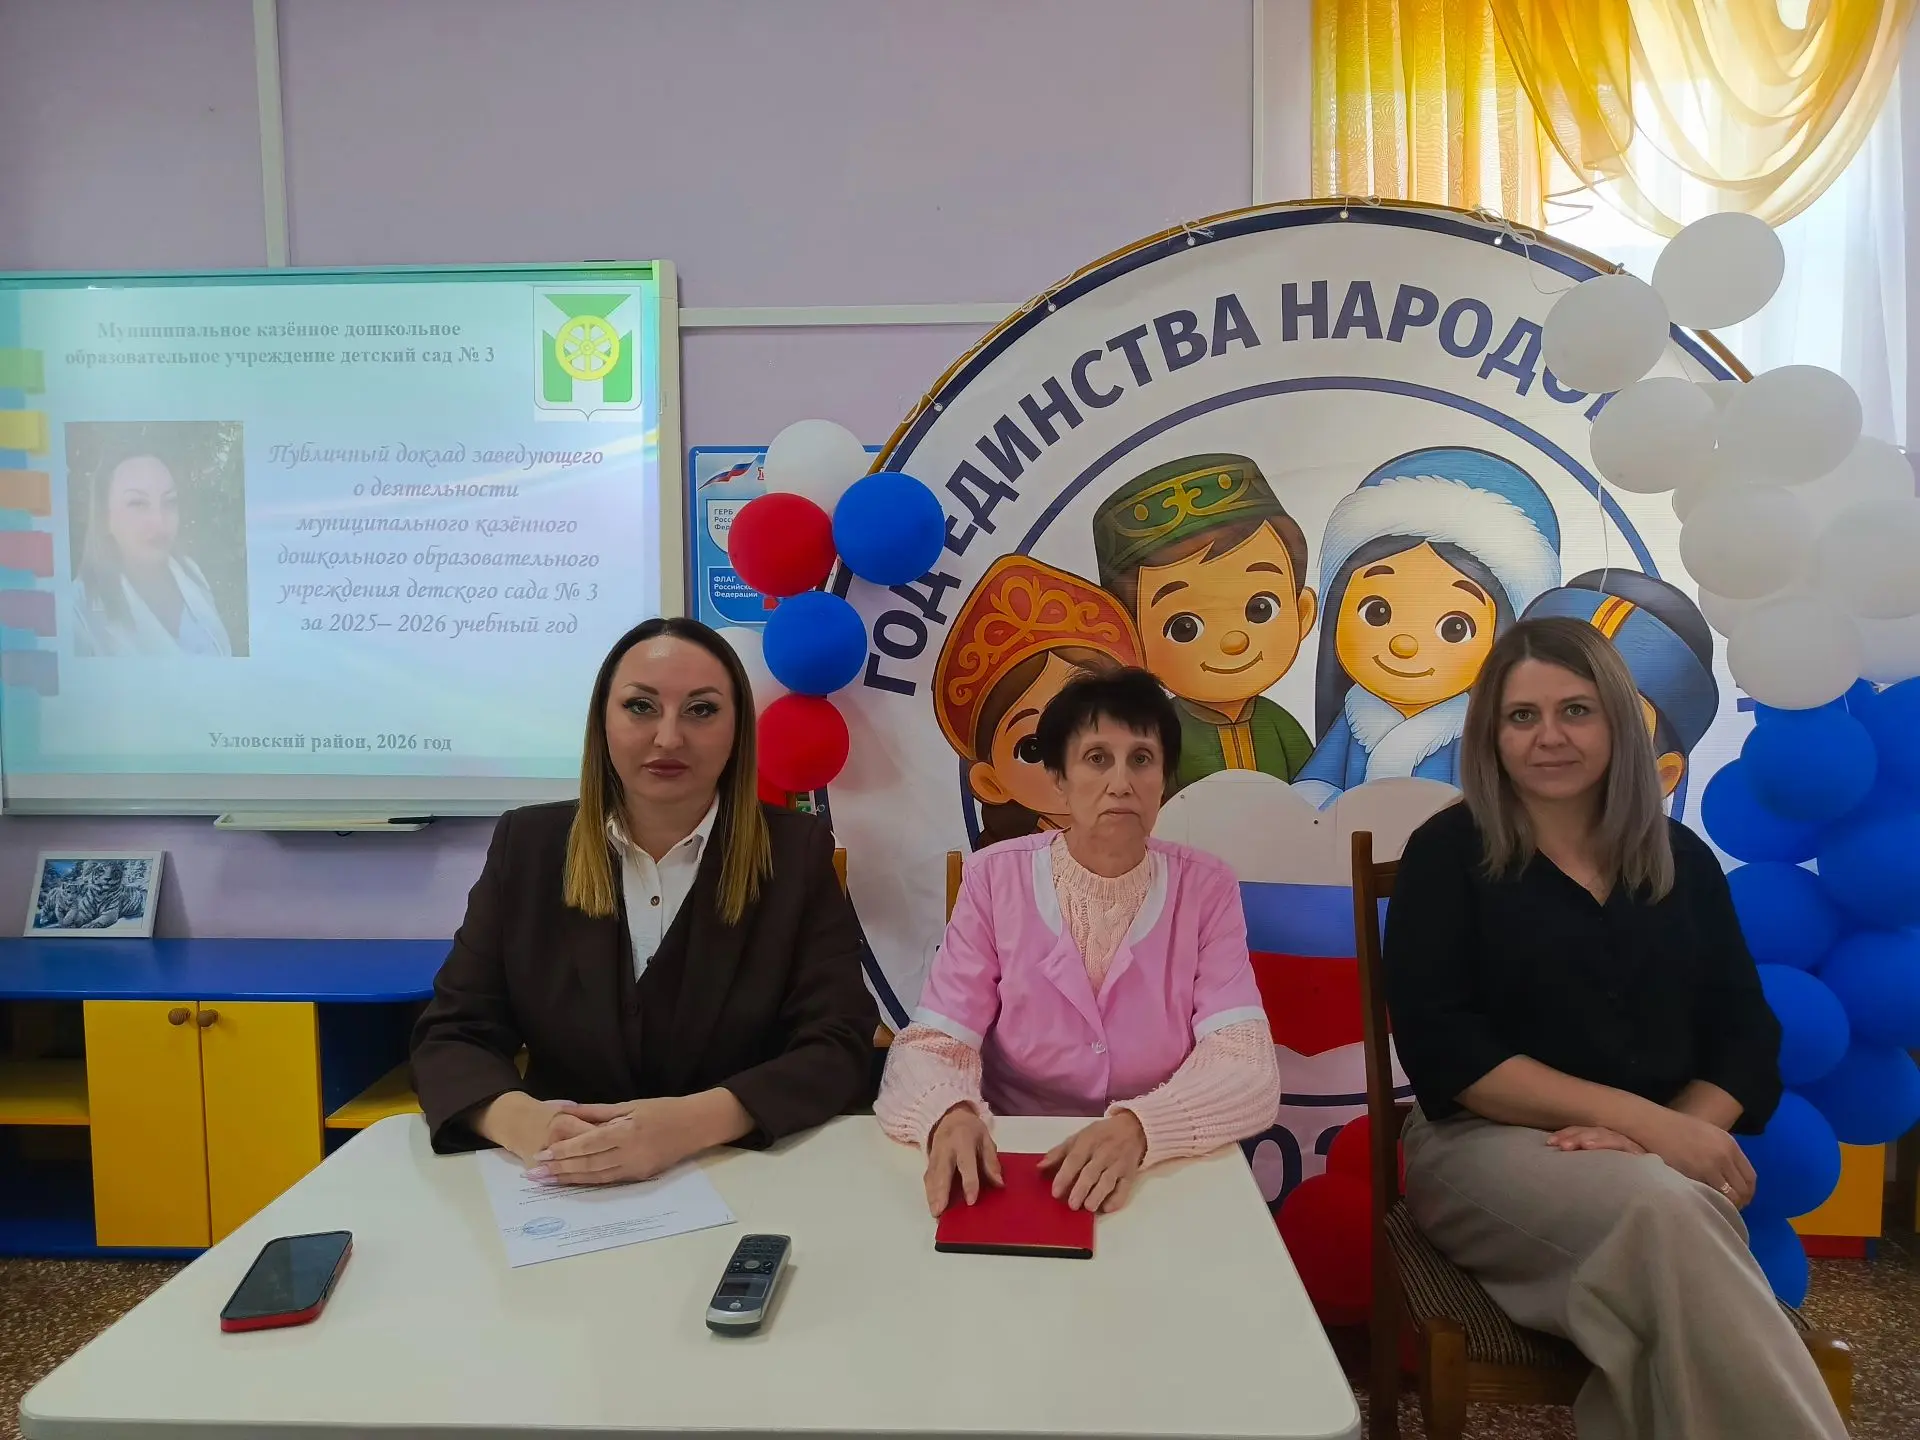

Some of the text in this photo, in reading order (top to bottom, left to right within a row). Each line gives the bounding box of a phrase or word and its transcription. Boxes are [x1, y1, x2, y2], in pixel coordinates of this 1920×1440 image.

[97, 321, 461, 343] Муниципальное казённое дошкольное
[64, 346, 495, 368] образовательное учреждение детский сад № 3
[267, 441, 604, 471] Публичный доклад заведующего
[353, 475, 519, 498] о деятельности
[863, 279, 1622, 697] ГОД ЕДИНСТВА НАРОД
[714, 508, 734, 516] ГЕРБ
[296, 515, 578, 538] муниципального казённого
[277, 543, 600, 573] дошкольного образовательного
[276, 576, 599, 604] учреждения детского сада № 3
[713, 575, 736, 583] ФЛАГ
[714, 591, 758, 600] Федерации
[301, 616, 324, 631] за
[397, 614, 447, 633] 2026
[449, 612, 539, 639] учебный
[544, 613, 578, 634] год
[208, 732, 452, 753] Узловский район, 2026 год
